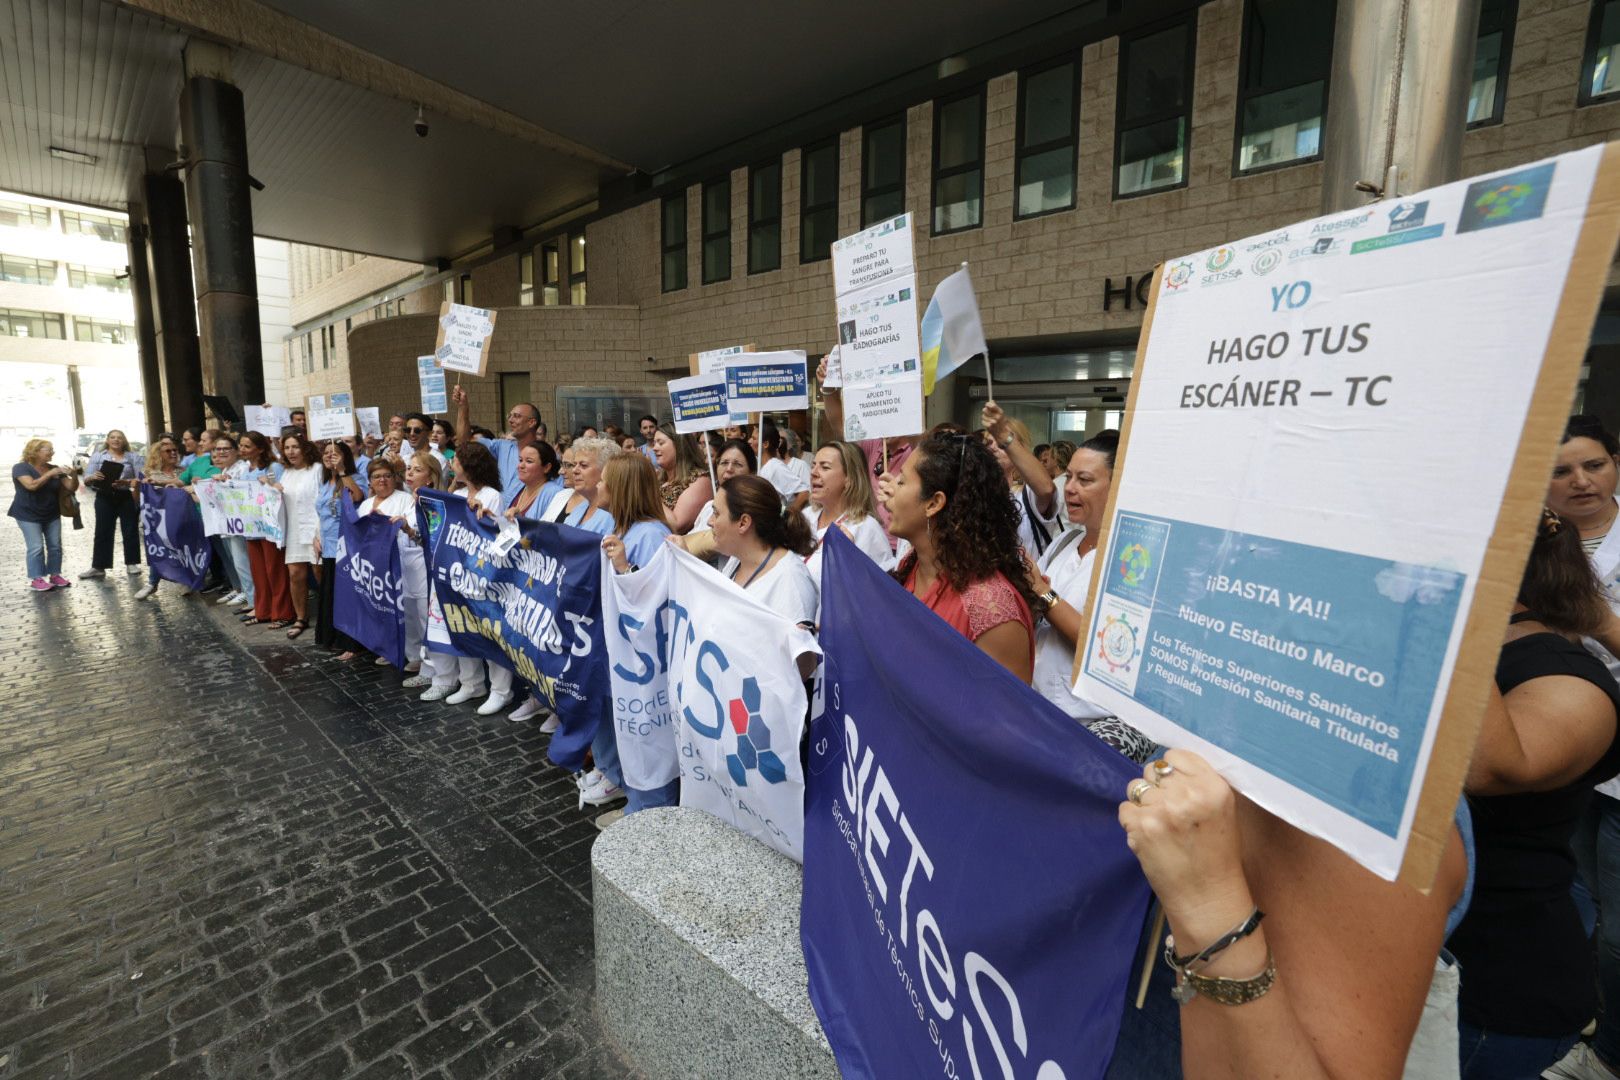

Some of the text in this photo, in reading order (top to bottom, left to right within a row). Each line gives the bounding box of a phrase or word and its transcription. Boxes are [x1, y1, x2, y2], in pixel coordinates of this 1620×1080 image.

[875, 258, 889, 268] PARA
[1271, 281, 1312, 312] YO
[859, 323, 892, 338] HAGO TUS
[1207, 322, 1371, 364] HAGO TUS
[1180, 375, 1302, 408] ESCÁNER
[1345, 375, 1392, 406] TC
[227, 518, 244, 534] NO
[1288, 593, 1332, 621] YA!!
[1178, 604, 1225, 633] Nuevo
[1229, 621, 1308, 661] Estatuto
[1313, 648, 1385, 688] Marco
[1146, 662, 1153, 673] y
[1155, 664, 1203, 697] Regulada
[1153, 631, 1400, 740] Los Técnicos Superiores Sanitarios
[1150, 646, 1399, 763] SOMOS Profesión Sanitaria Titulada
[874, 908, 885, 936] de
